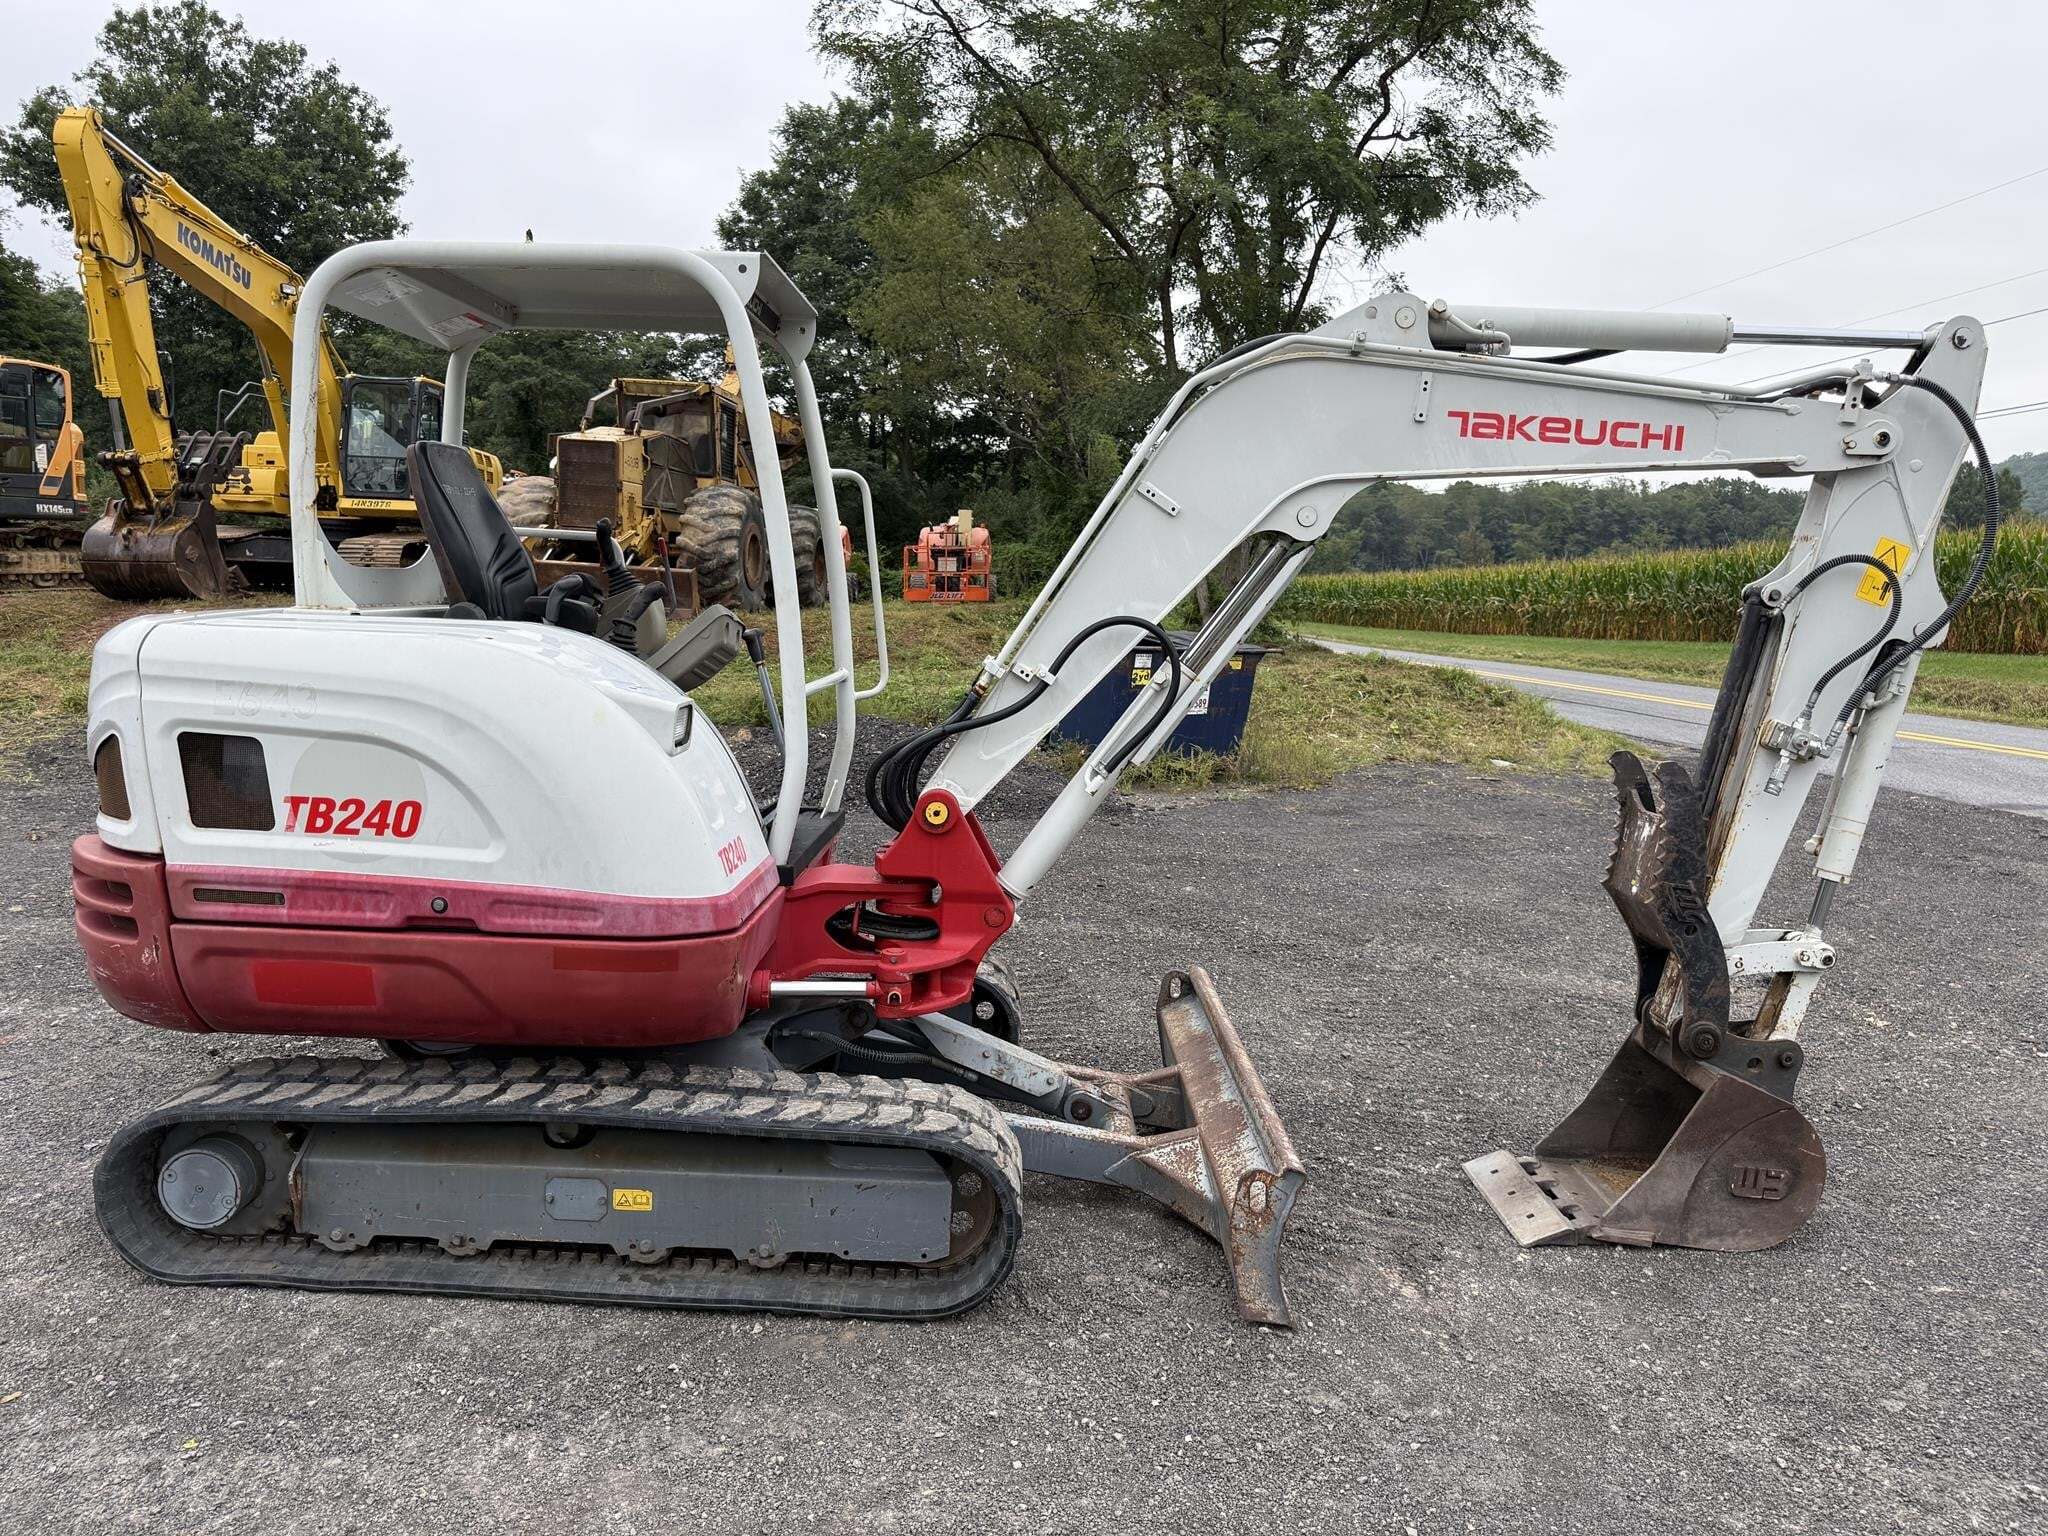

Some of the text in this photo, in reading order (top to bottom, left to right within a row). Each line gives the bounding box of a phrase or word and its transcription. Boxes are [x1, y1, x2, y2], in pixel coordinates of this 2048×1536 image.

[177, 221, 252, 290] KOMATSU
[283, 795, 423, 840] TB240
[717, 835, 748, 878] TB240
